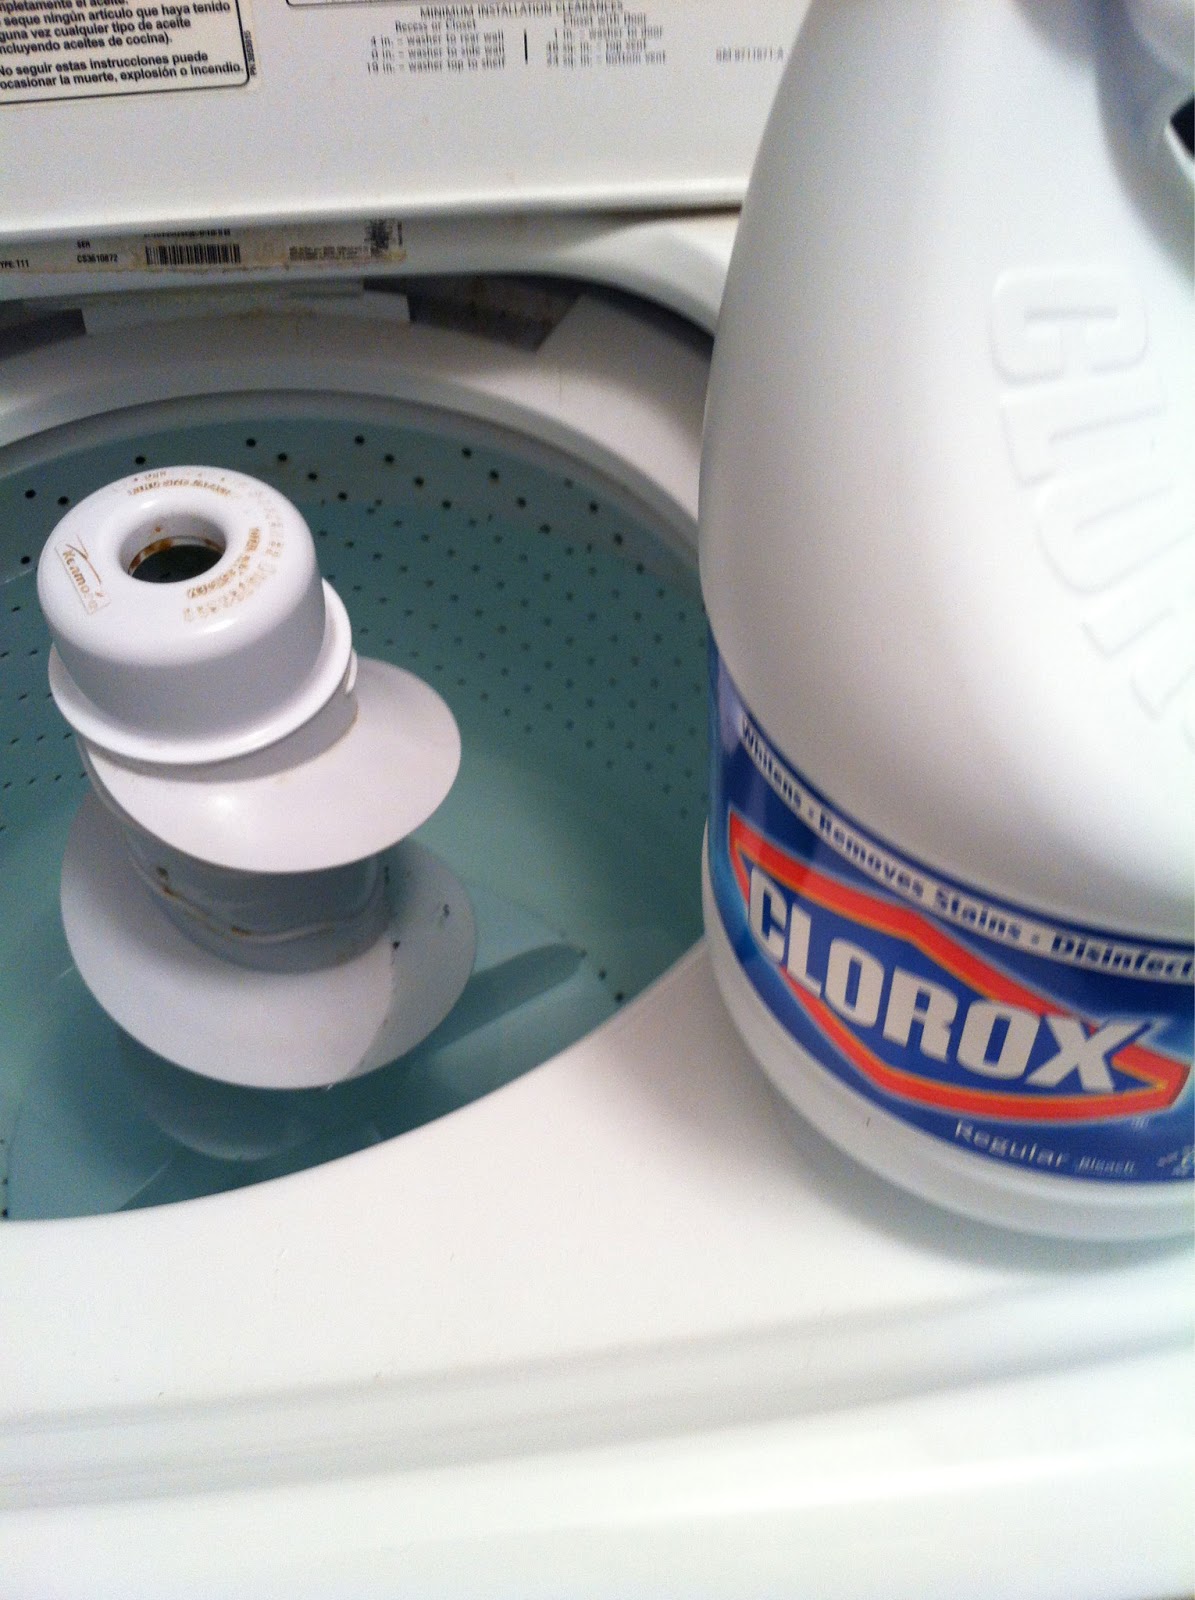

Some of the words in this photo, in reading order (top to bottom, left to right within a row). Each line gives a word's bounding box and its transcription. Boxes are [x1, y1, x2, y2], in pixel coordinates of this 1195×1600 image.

[4, 14, 40, 28] seque
[43, 10, 86, 26] ningún
[136, 7, 159, 19] que
[161, 4, 191, 17] haya
[192, 0, 231, 13] tenido
[420, 4, 475, 20] MINIMUM
[30, 28, 51, 39] vez
[54, 22, 109, 37] cualquier
[111, 20, 135, 34] tipo
[138, 18, 153, 31] de
[156, 16, 191, 29] aceite
[63, 36, 105, 50] aceites
[107, 35, 123, 47] de
[0, 75, 56, 89] ocasionar
[59, 74, 70, 85] la
[73, 71, 118, 83] muerte,
[120, 66, 177, 82] explosión
[180, 67, 188, 76] o
[190, 61, 244, 75] incendio.
[15, 62, 53, 77] seguir
[55, 59, 87, 73] estas
[90, 54, 169, 69] instrucciones
[172, 50, 208, 66] puede
[818, 806, 925, 900] Removes
[934, 884, 1022, 942] Stains
[748, 864, 1146, 1094] CLOROX
[955, 1118, 1070, 1168] Regular
